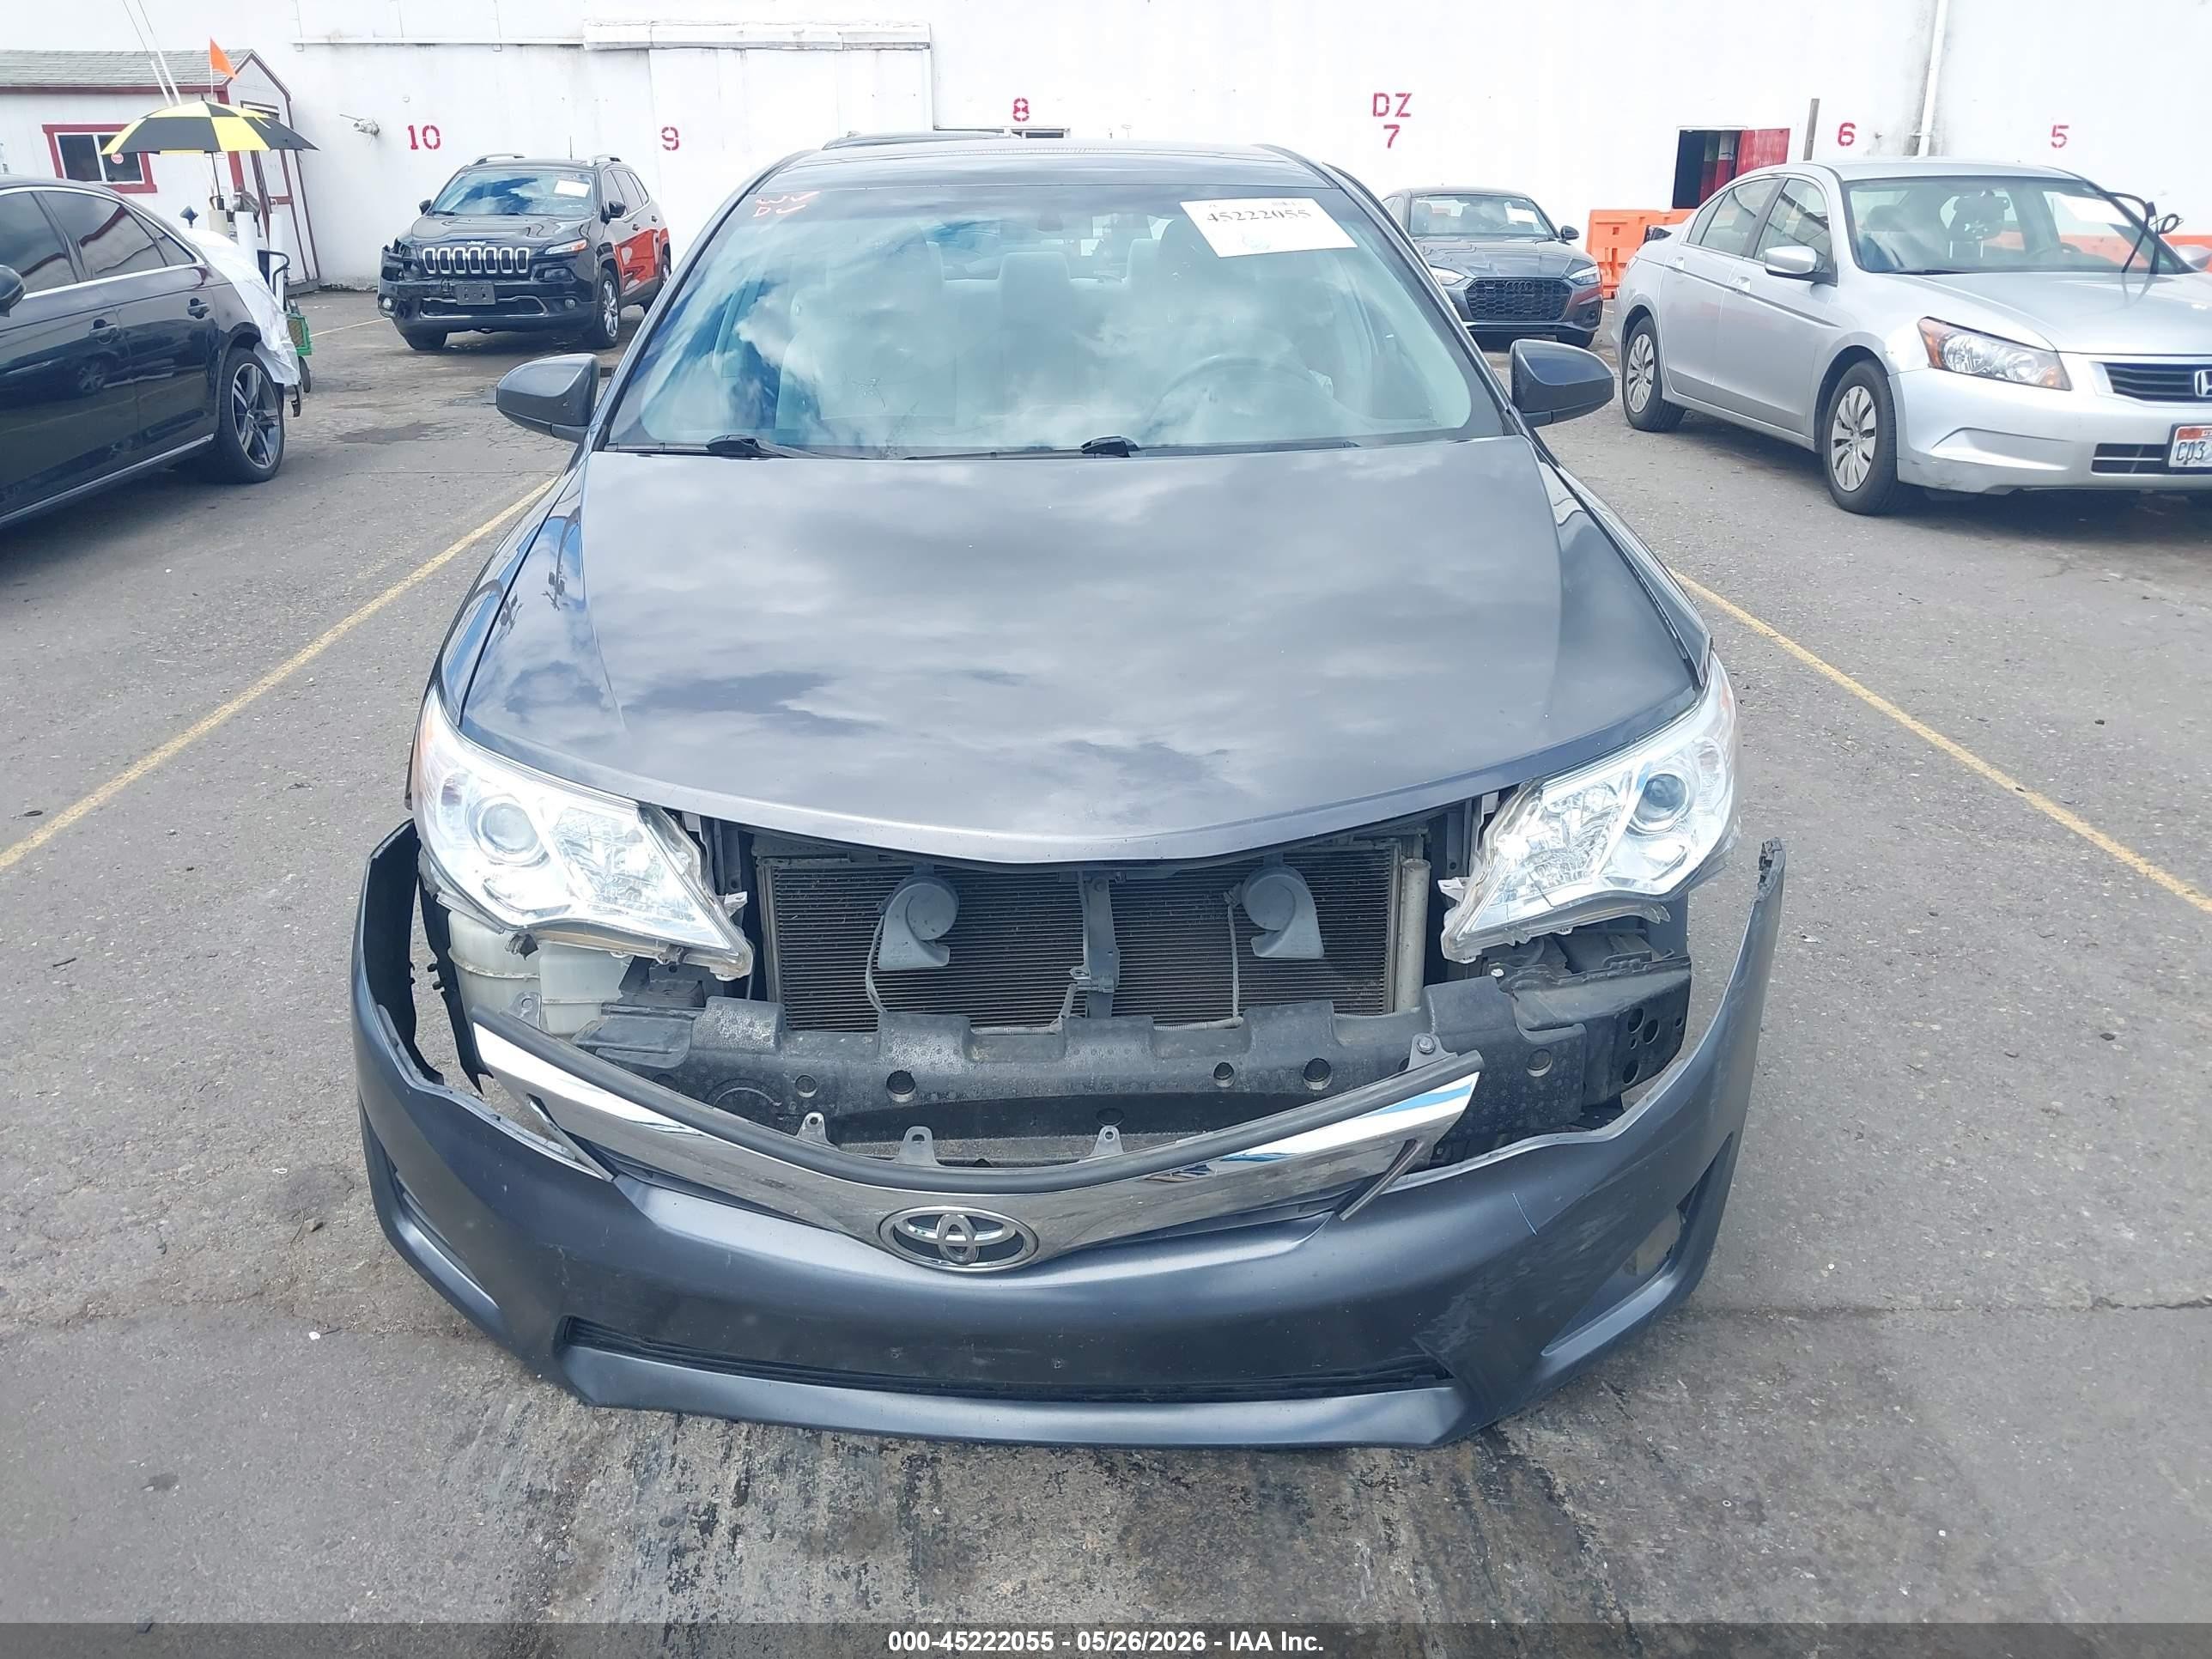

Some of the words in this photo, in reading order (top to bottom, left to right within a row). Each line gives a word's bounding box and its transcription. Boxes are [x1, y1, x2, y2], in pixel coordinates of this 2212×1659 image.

[1012, 98, 1030, 121] 8
[1373, 93, 1412, 117] DZ
[408, 125, 441, 150] 10
[661, 126, 679, 150] 9
[1383, 125, 1401, 149] 7
[1837, 122, 1856, 146] 6
[2051, 125, 2069, 148] 5
